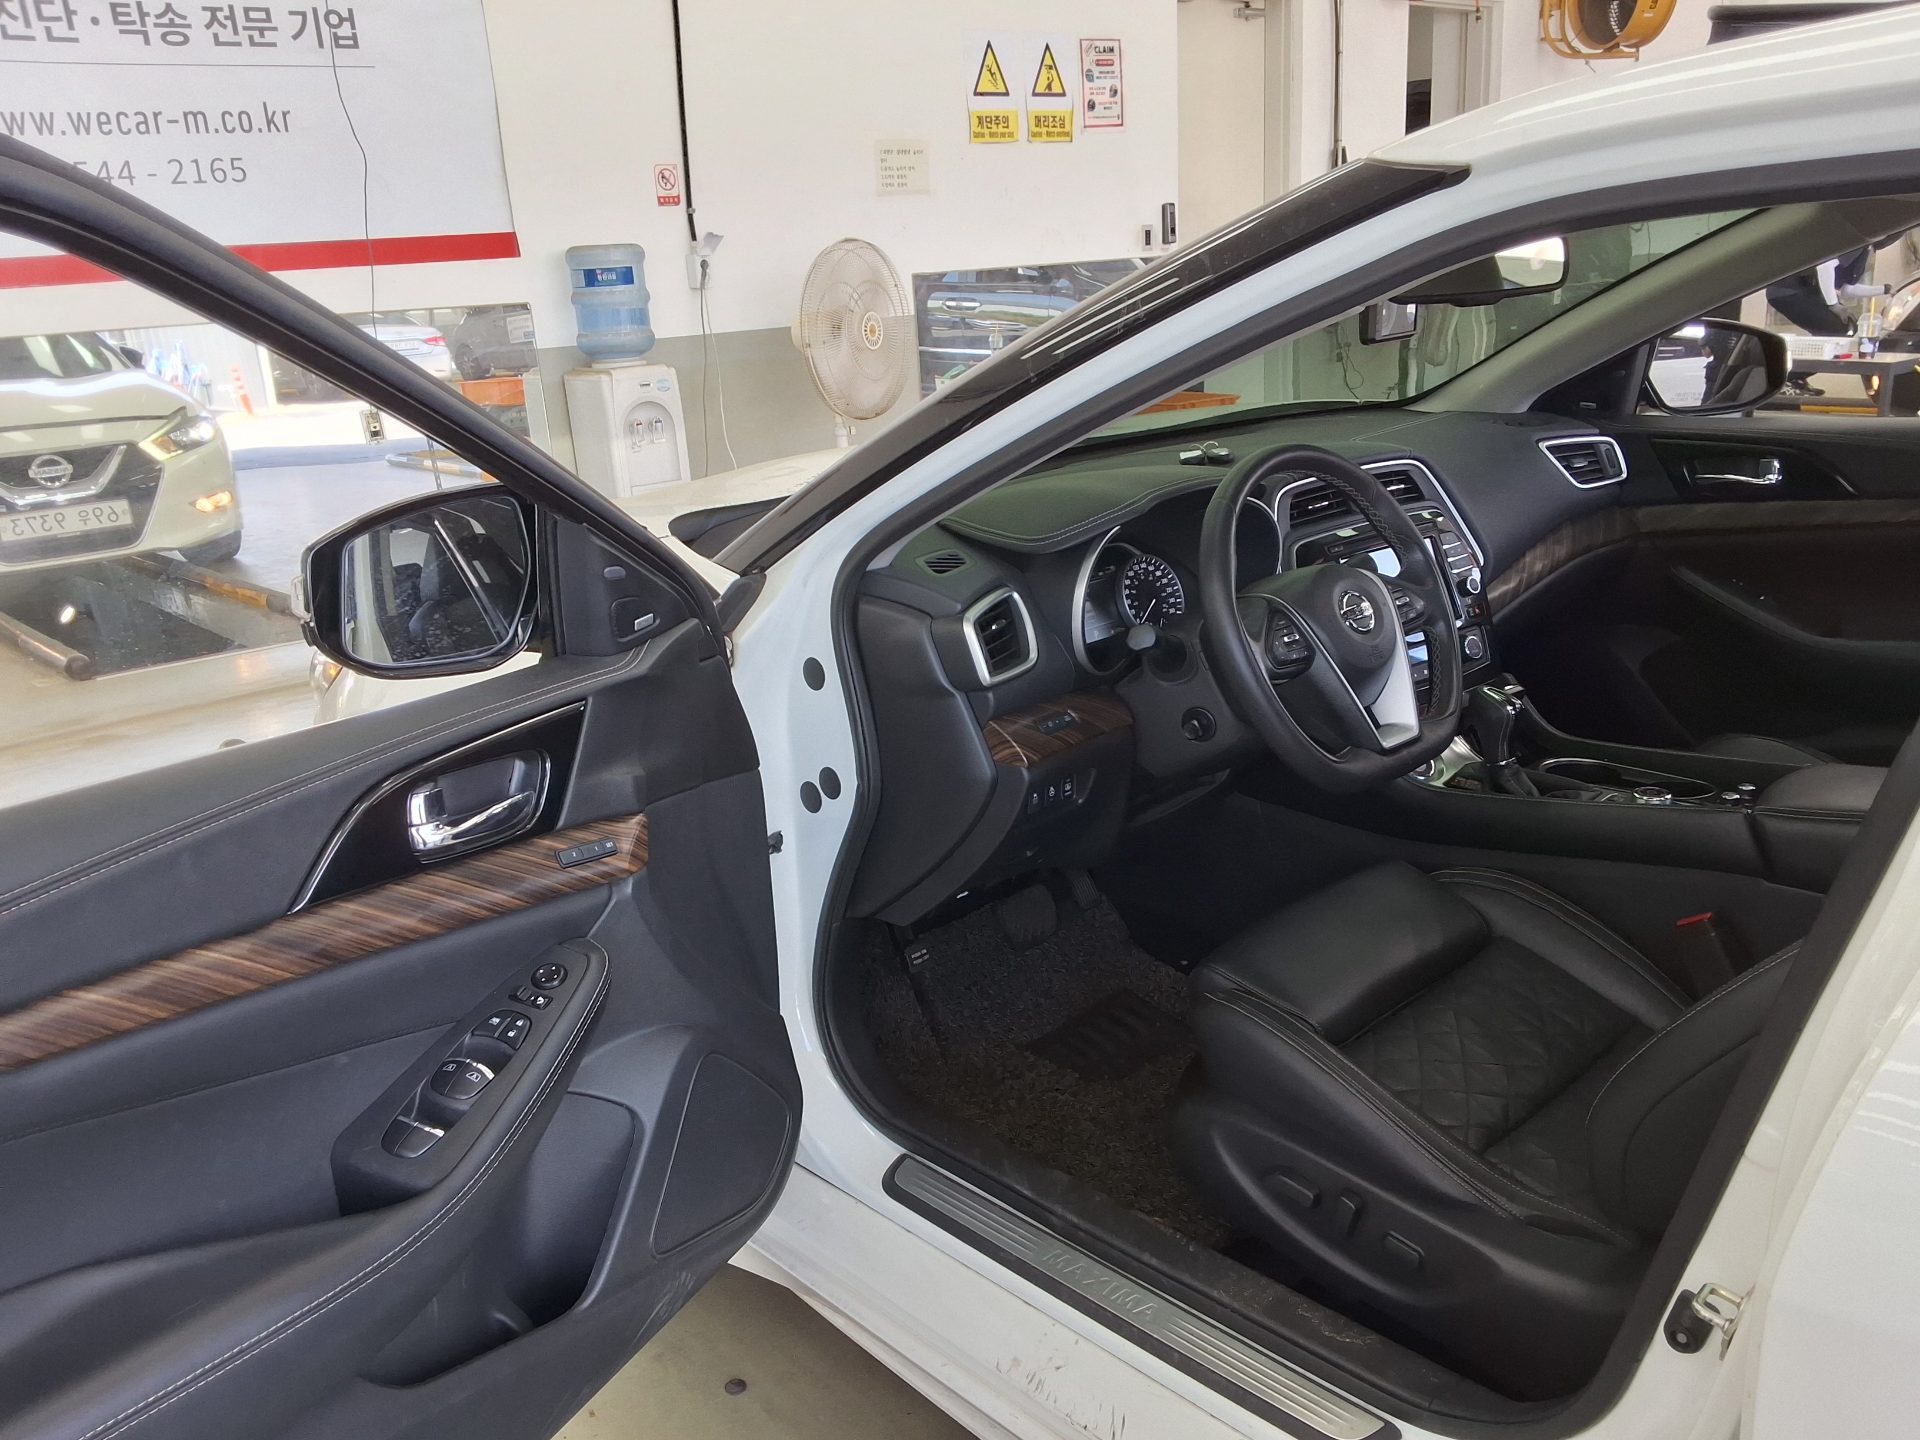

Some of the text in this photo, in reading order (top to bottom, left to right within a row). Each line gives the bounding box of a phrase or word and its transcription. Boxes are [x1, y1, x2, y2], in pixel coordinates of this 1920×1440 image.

[201, 4, 279, 48] 전문
[287, 7, 360, 49] 기업
[1094, 45, 1115, 54] CLAIM
[976, 115, 1010, 129] 계단주의
[1034, 115, 1066, 129] 머리조심
[73, 159, 136, 186] 44
[167, 157, 247, 185] 2165
[1042, 1249, 1158, 1320] MAXIMA
